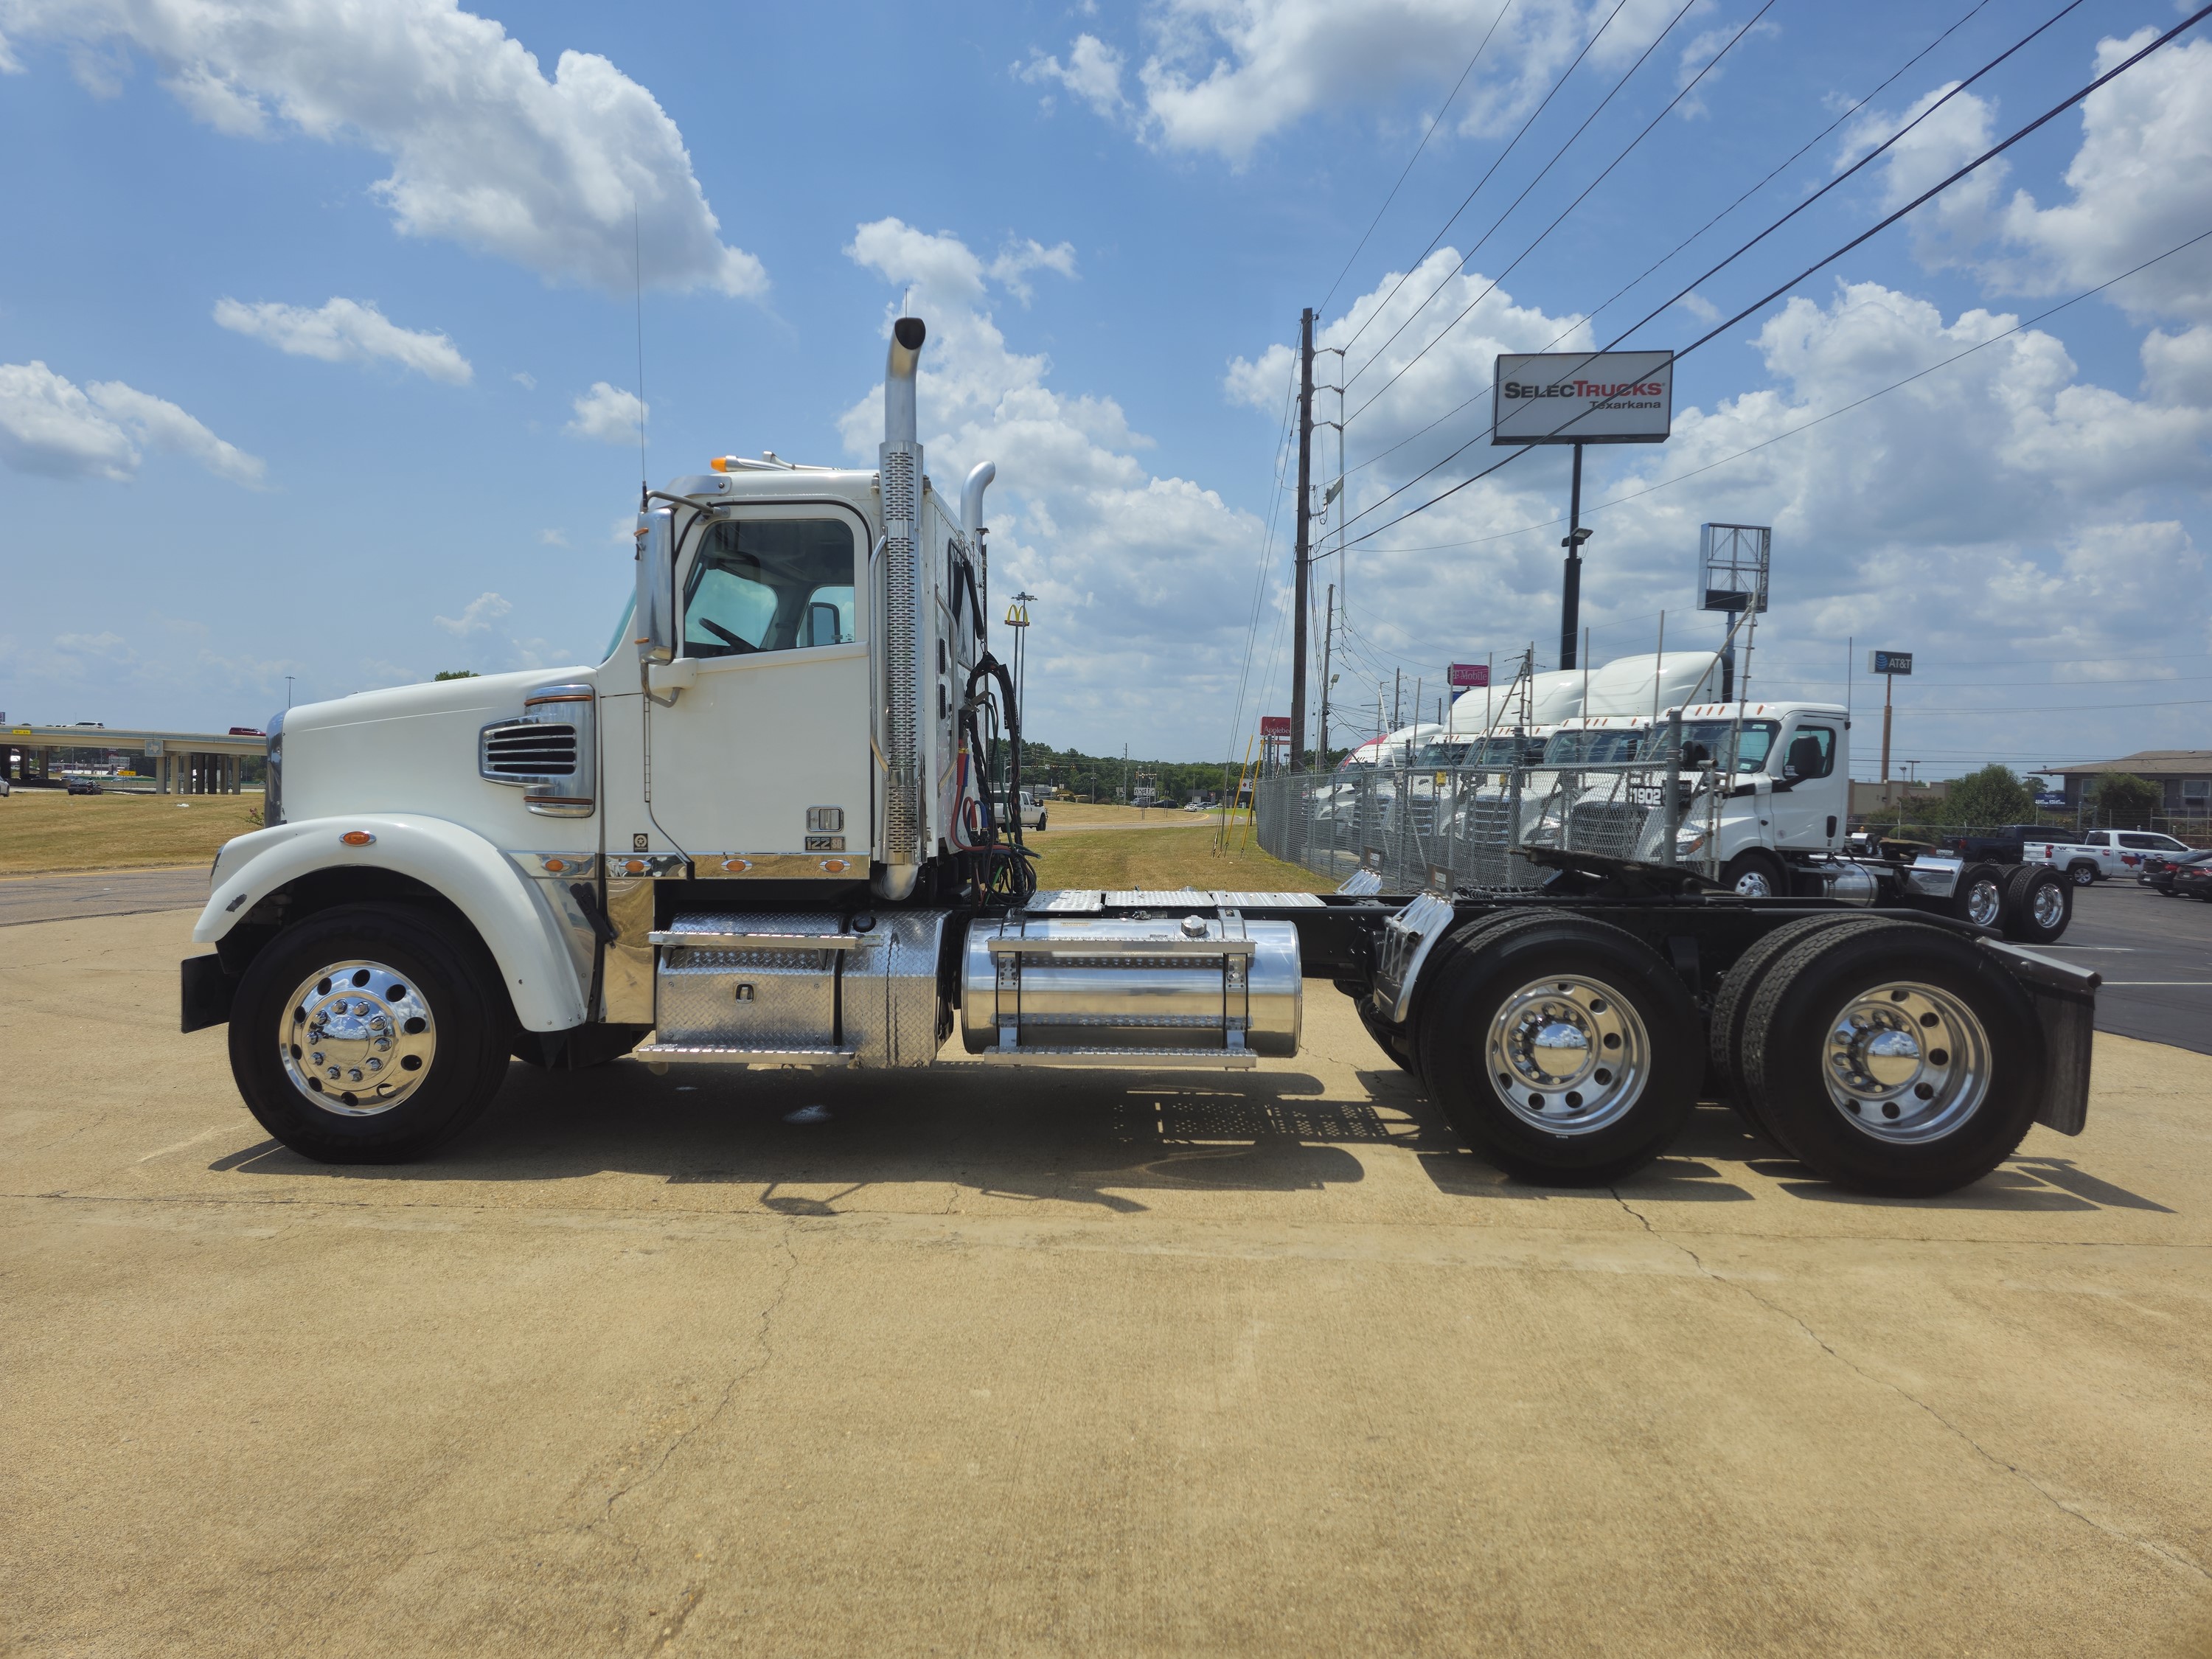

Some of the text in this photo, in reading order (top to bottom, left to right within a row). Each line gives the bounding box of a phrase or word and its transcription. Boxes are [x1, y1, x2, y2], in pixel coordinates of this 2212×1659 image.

[1589, 400, 1661, 410] Texarkana
[1888, 658, 1911, 669] AT&T
[1264, 726, 1290, 735] Applebe
[1632, 787, 1661, 805] 1902
[806, 837, 830, 850] 122
